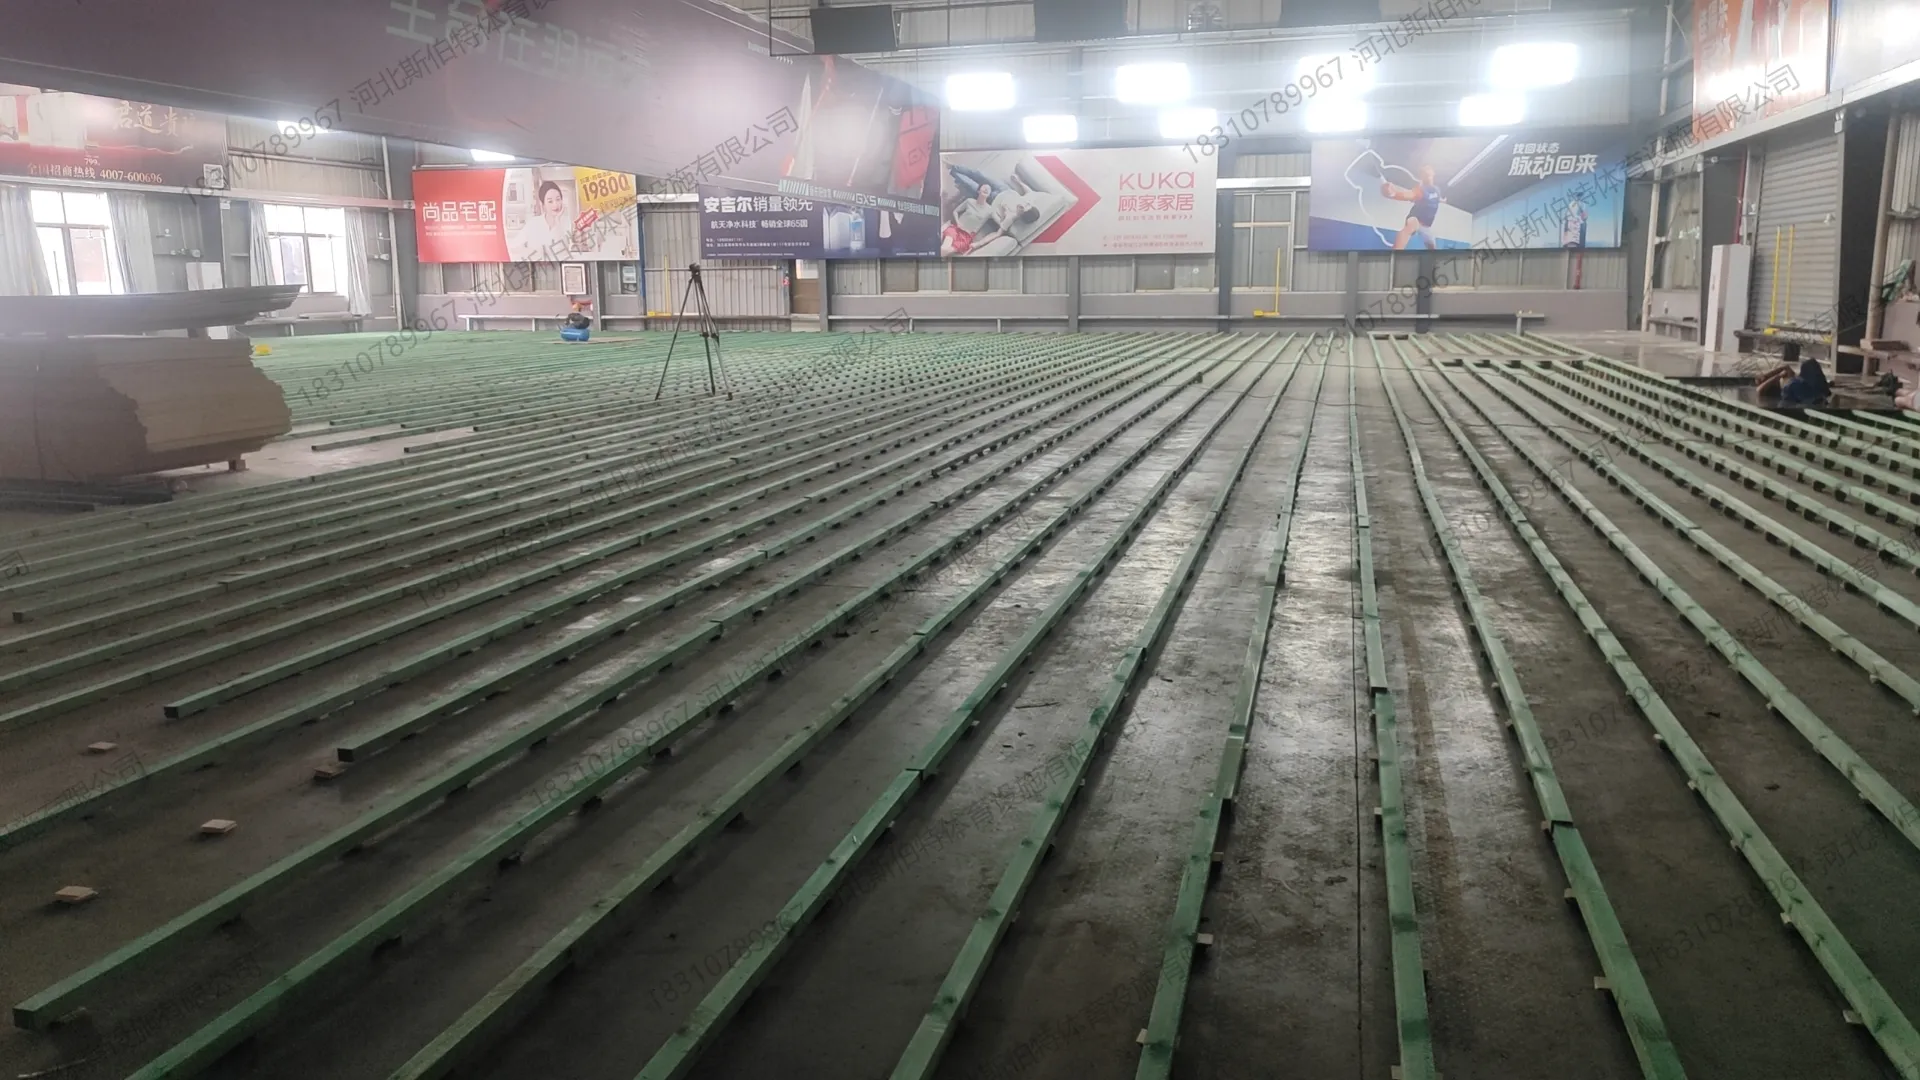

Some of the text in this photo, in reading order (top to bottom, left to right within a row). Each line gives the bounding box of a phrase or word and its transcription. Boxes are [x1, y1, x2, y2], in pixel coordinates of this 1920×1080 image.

[1512, 142, 1560, 154] 找回状态
[27, 163, 162, 184] 全国招商热线 4007-600696
[1508, 153, 1598, 179] 脉动回来
[422, 200, 497, 222] 尚品宅配
[703, 195, 813, 214] 安吉尔销量领先
[1118, 193, 1195, 212] 顾家家居
